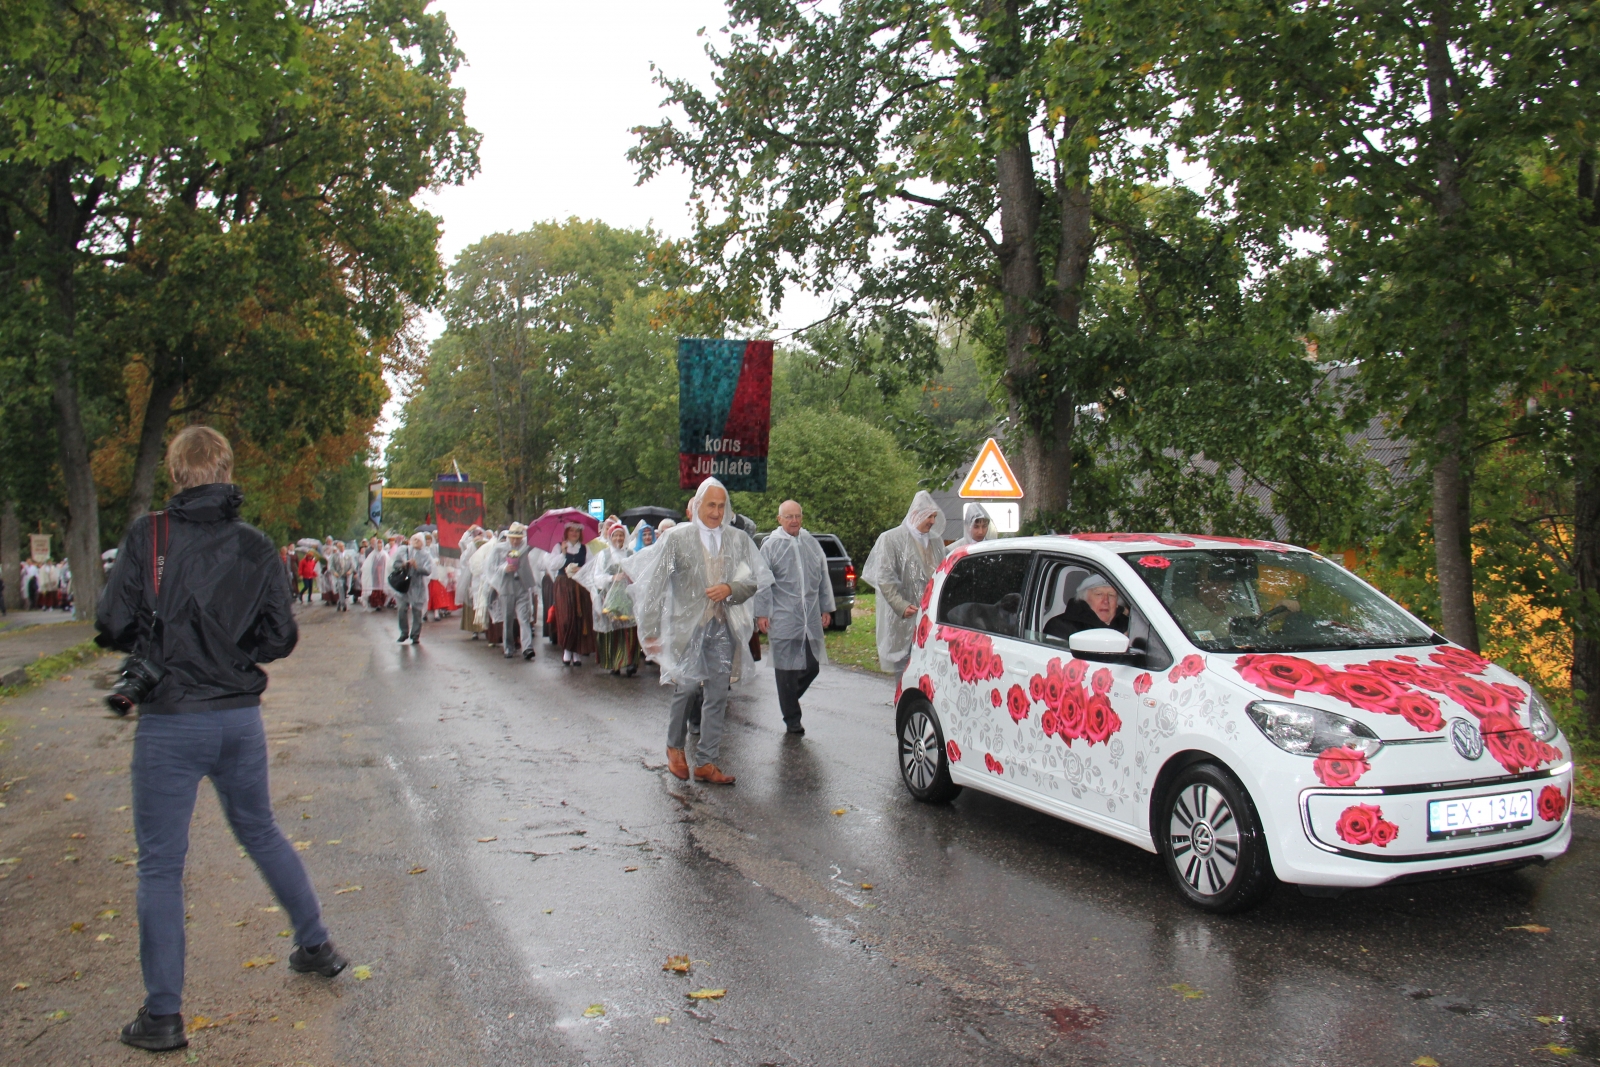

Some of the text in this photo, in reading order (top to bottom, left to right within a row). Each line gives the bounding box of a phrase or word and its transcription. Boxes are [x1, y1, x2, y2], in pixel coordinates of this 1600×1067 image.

[704, 434, 741, 452] koris
[692, 456, 752, 476] Jubilate
[1446, 795, 1528, 826] EX-1342
